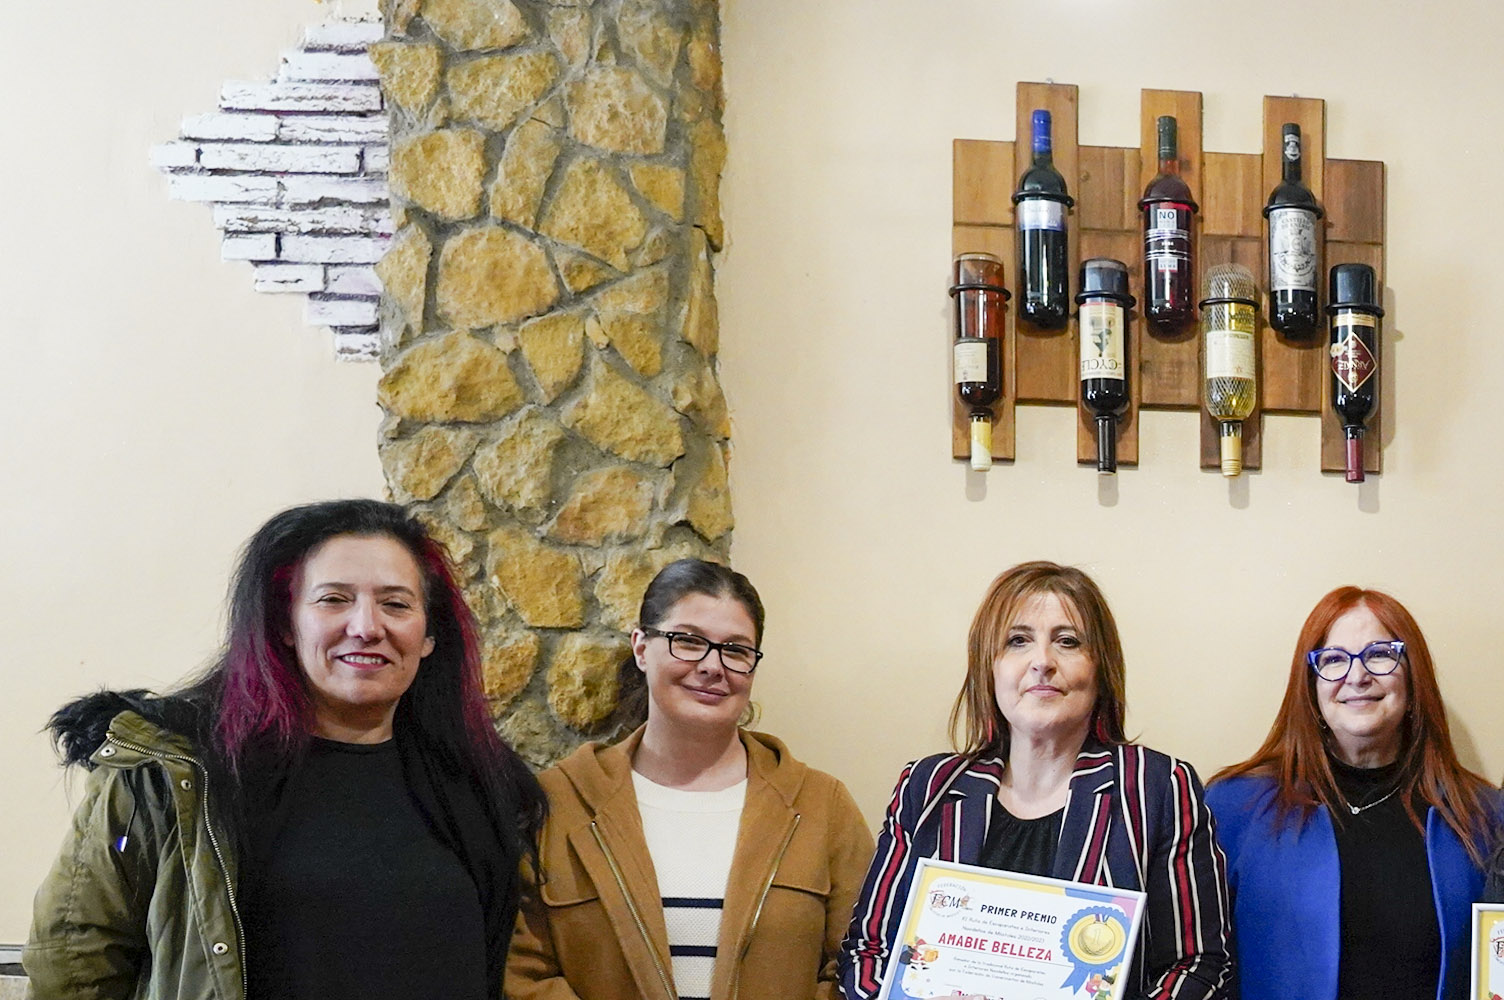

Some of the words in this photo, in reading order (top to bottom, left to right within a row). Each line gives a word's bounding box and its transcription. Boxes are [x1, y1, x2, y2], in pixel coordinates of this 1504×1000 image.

[1159, 211, 1176, 220] NO
[980, 903, 1018, 918] PRIMER
[1019, 909, 1057, 925] PREMIO
[937, 931, 988, 951] AMABIE
[991, 939, 1053, 962] BELLEZA
